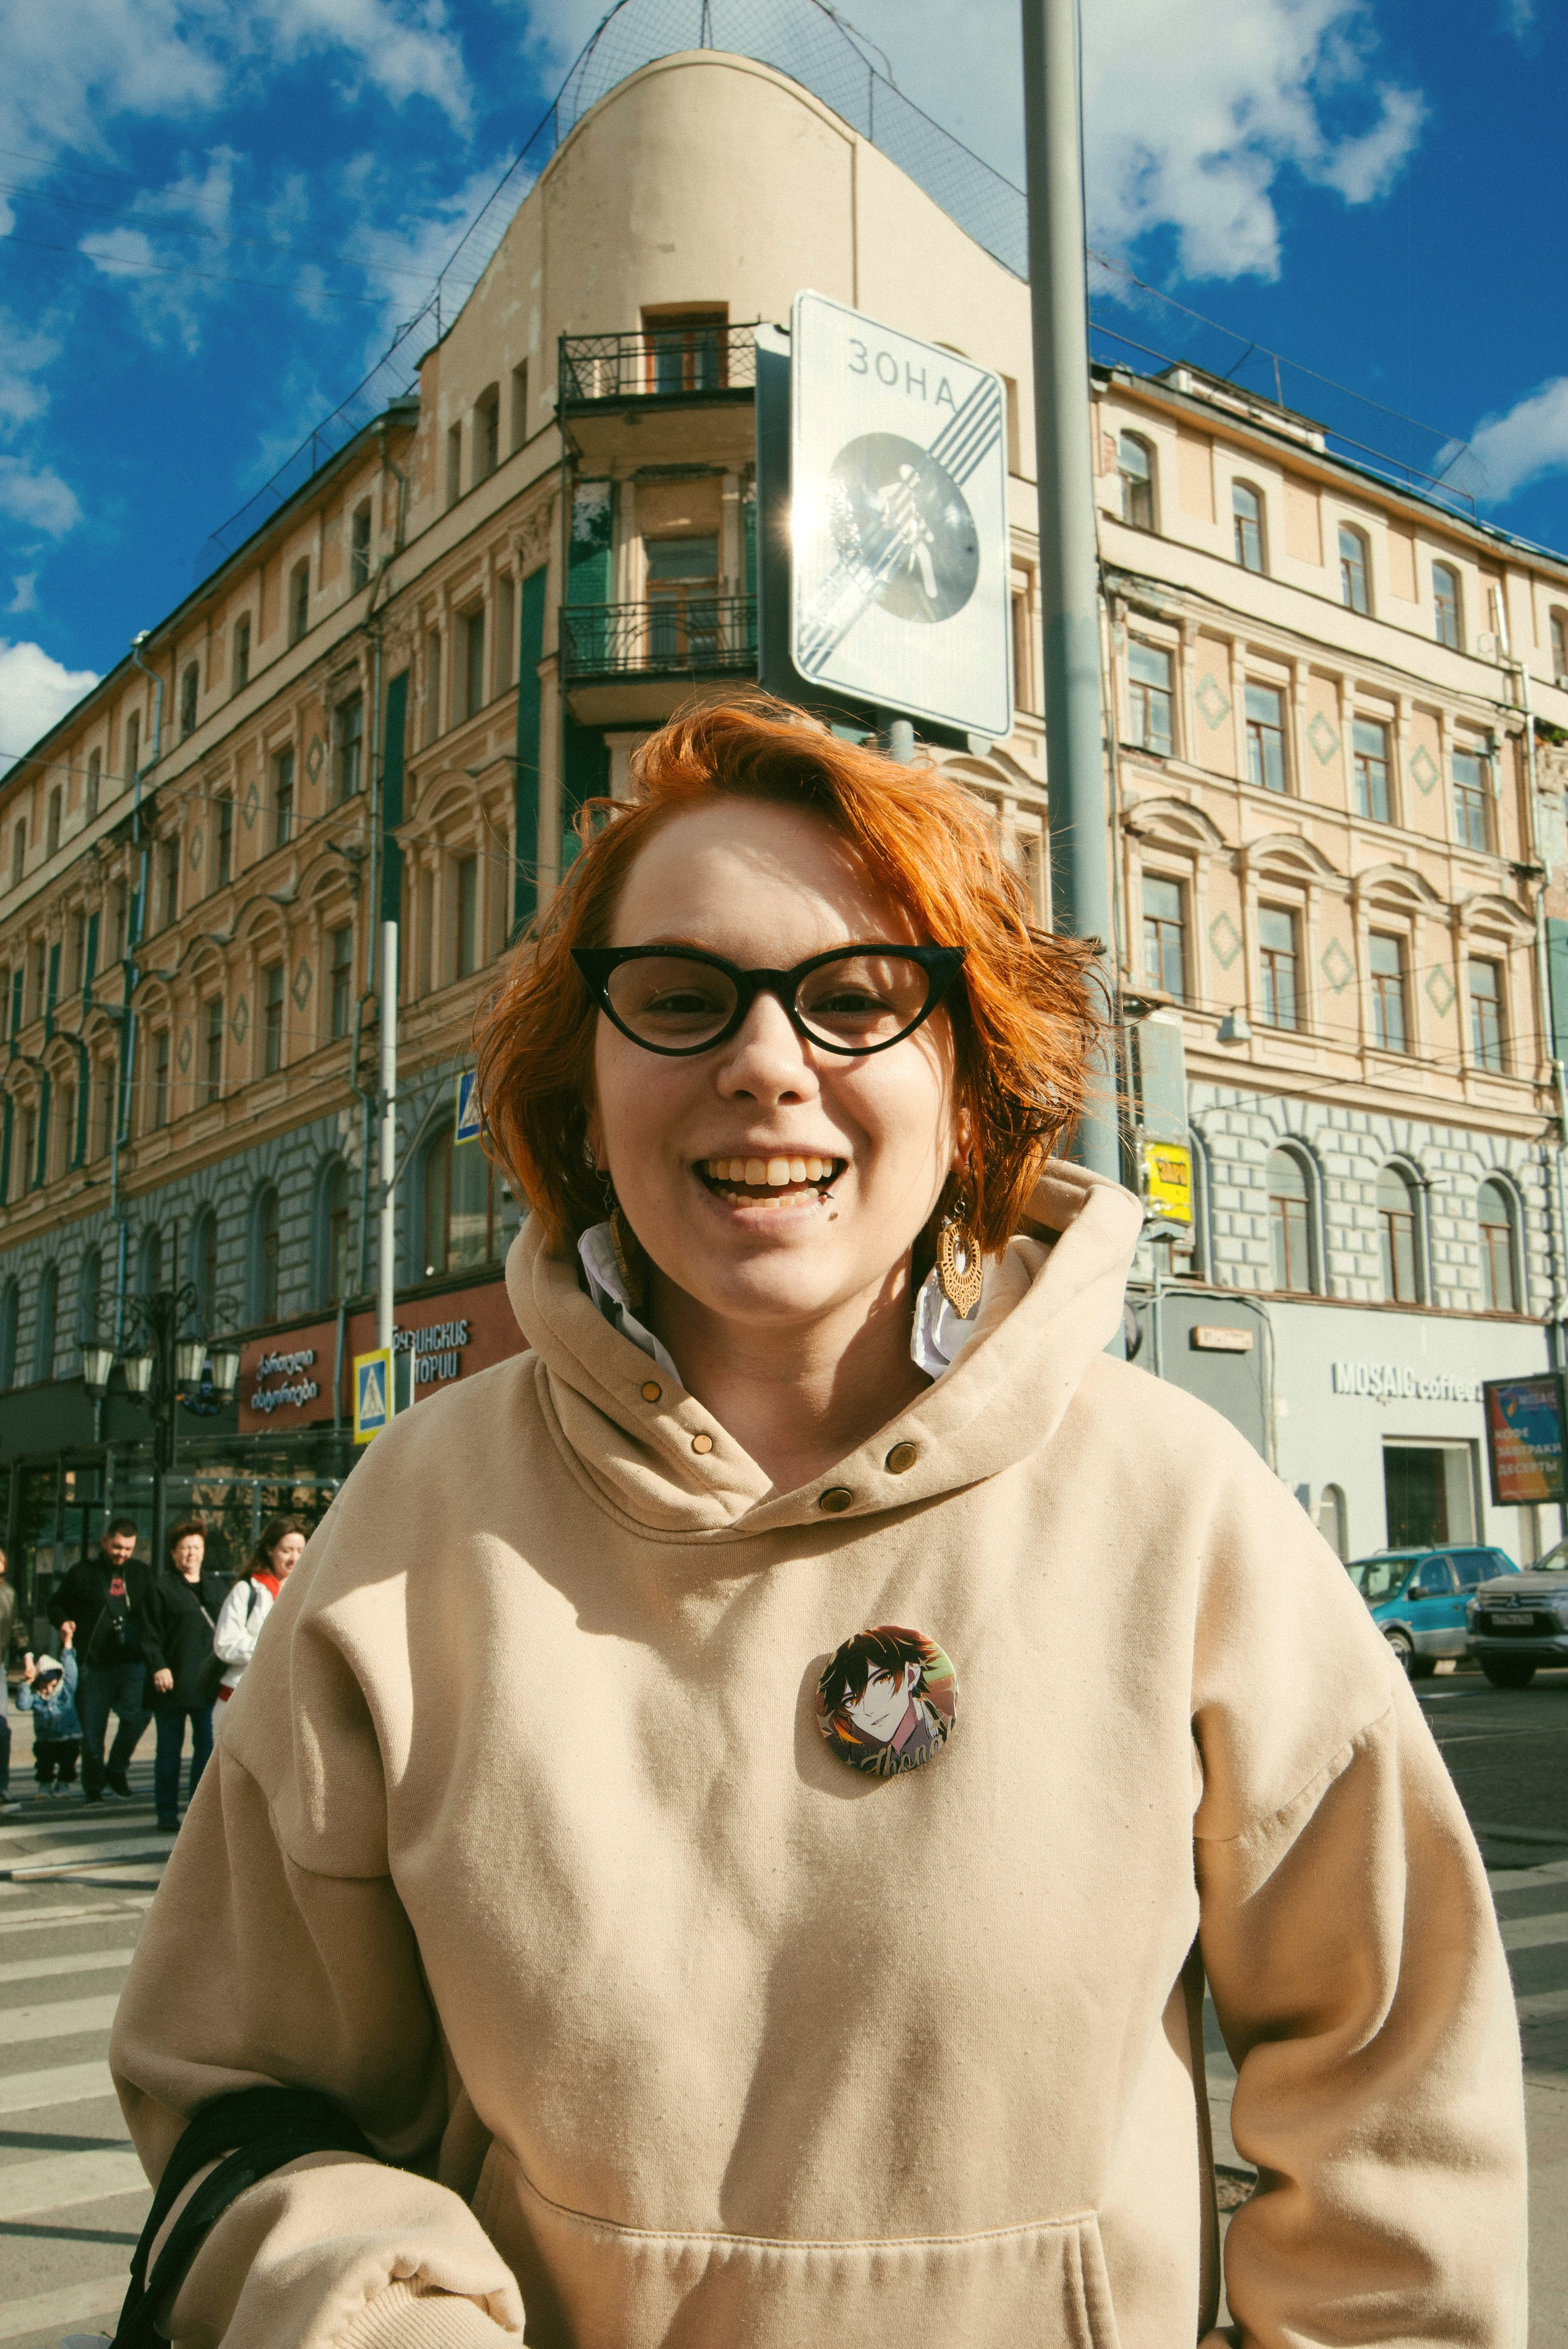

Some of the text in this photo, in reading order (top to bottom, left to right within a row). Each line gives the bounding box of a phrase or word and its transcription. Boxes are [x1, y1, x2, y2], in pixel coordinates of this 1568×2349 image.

[848, 338, 959, 414] ЗОНА
[393, 1319, 468, 1354] РУЗИНСКИЕ
[415, 1351, 458, 1384] ТОРИИ
[1332, 1362, 1415, 1398] MOSAIC
